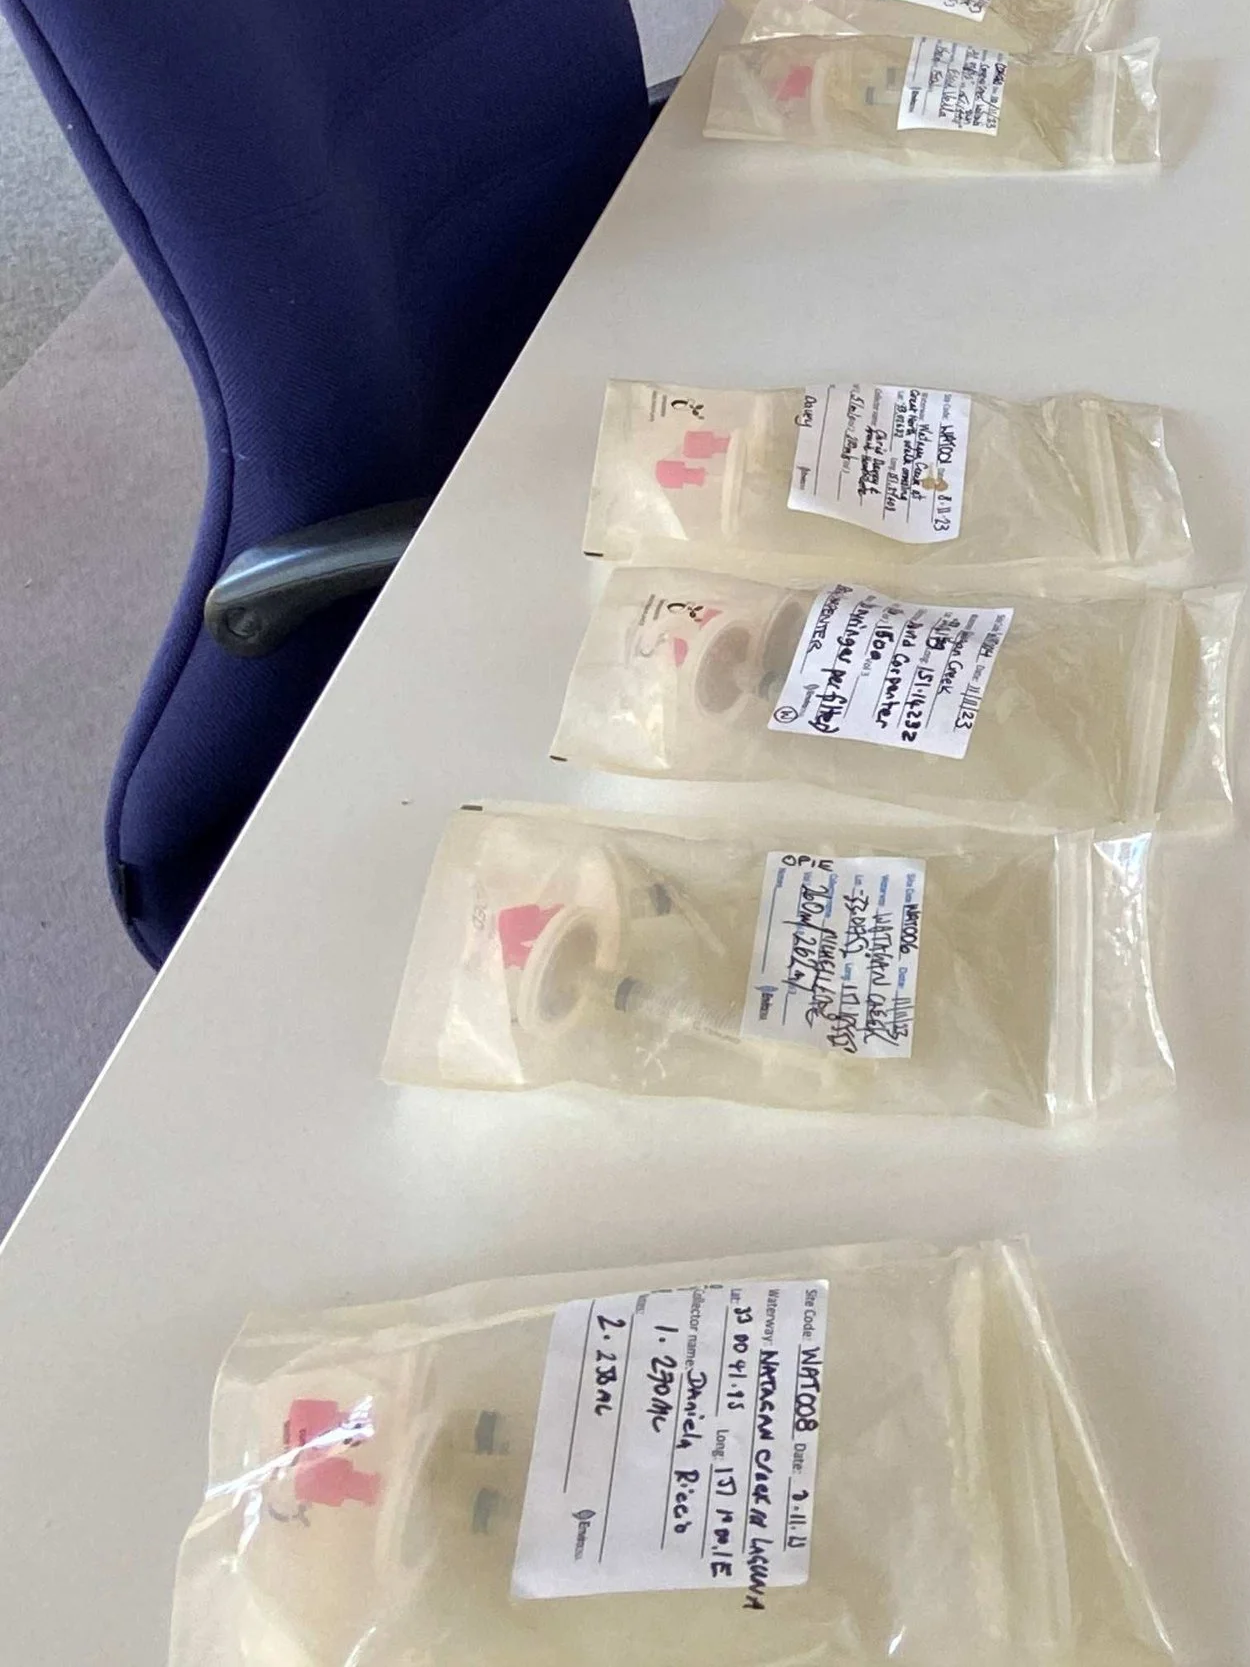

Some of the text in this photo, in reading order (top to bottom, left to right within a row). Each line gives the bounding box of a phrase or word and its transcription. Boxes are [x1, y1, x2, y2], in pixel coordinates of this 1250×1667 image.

[795, 395, 817, 428] Davey
[937, 660, 963, 694] Creek
[782, 855, 833, 871] OPIE
[867, 912, 893, 986] WATAGAN
[762, 1289, 780, 1347] Waterway:
[684, 1335, 698, 1370] name:
[791, 1289, 820, 1473] Site Code: WAT008 Date:
[711, 1429, 730, 1460] Long:
